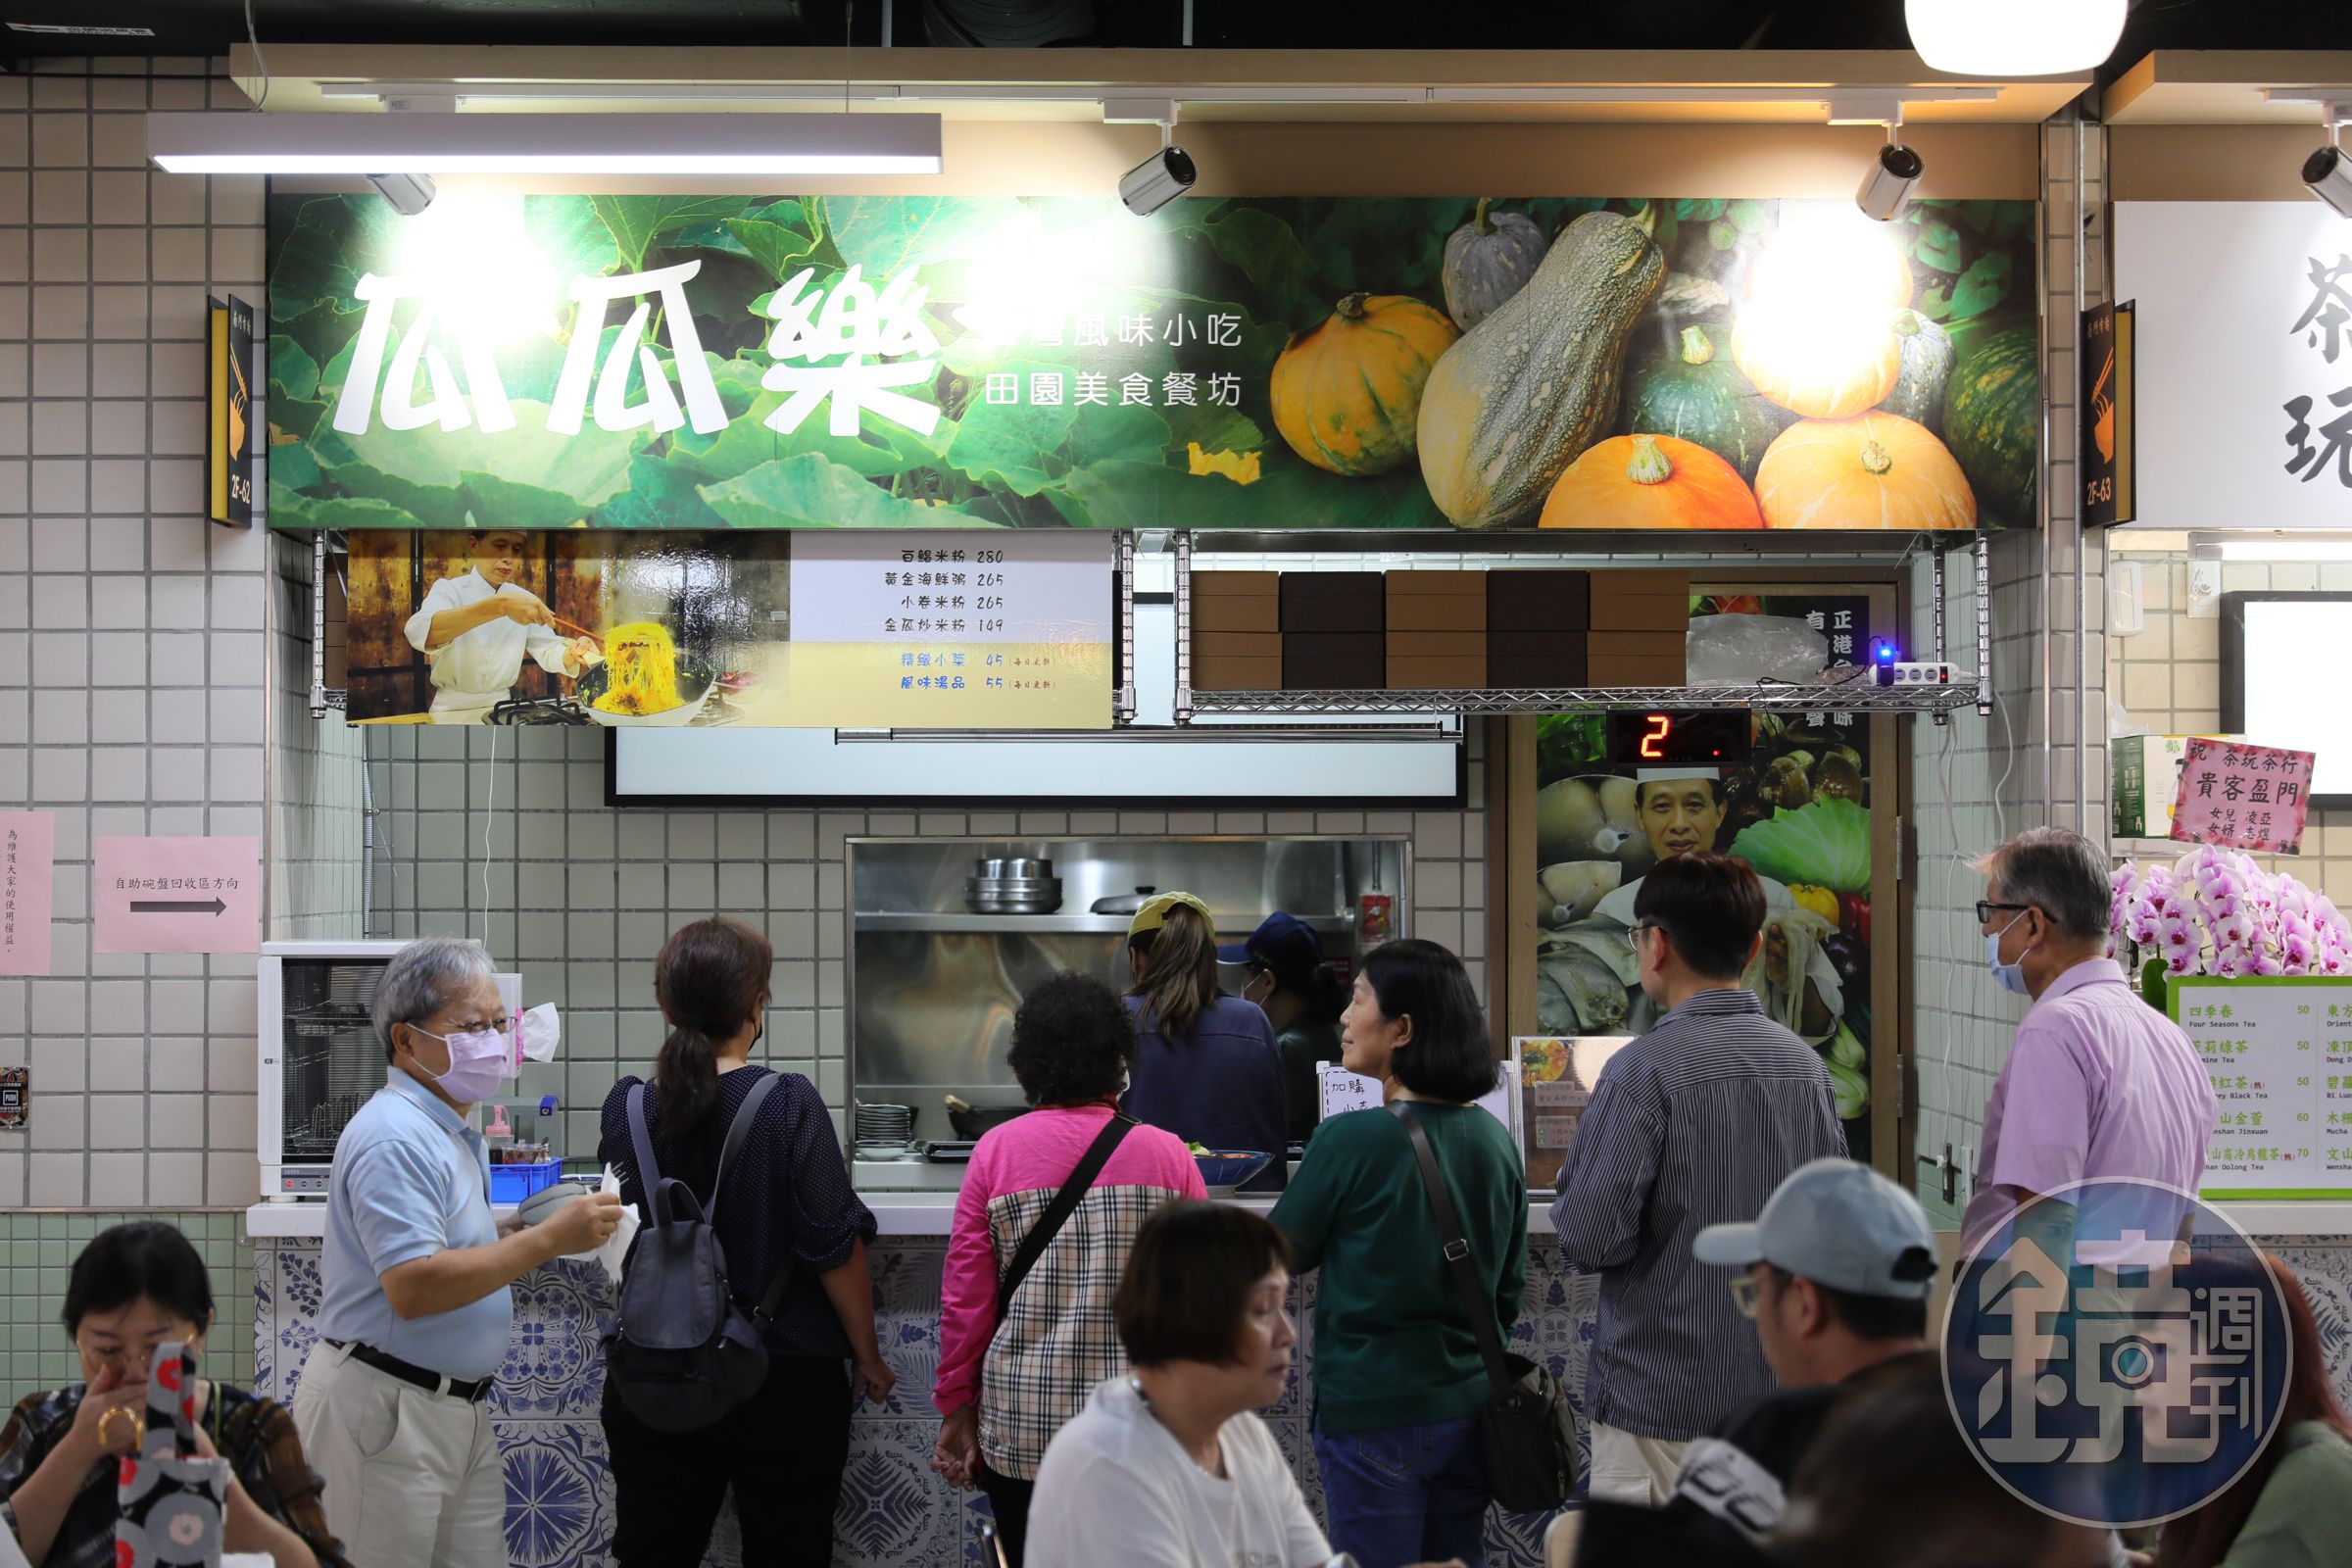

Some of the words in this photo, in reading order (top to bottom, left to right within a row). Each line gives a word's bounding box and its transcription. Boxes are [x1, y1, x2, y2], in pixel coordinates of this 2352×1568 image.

[1029, 312, 1243, 347] 風味小吃
[332, 259, 942, 438] 瓜瓜樂
[985, 371, 1242, 407] 田園美食餐坊
[231, 474, 251, 505] 2F-62
[2086, 477, 2111, 506] 2F-63
[977, 550, 1004, 564] 280
[884, 572, 966, 586] 黃金海鮮粥
[977, 573, 1004, 587] 265
[901, 596, 965, 610] 小卷米粉
[977, 596, 1004, 610] 265
[884, 618, 966, 632] 金瓜炒米粉
[979, 619, 1004, 632] 149
[986, 654, 1004, 666] 45
[1834, 611, 1853, 727] 正港味
[901, 676, 965, 690] 風味湯品
[986, 676, 1004, 689] 55
[1641, 715, 1669, 758] 2
[2189, 742, 2207, 761] 祝
[2222, 750, 2298, 774] 茶玩茶行
[2197, 771, 2299, 807] 貴客盈門
[2210, 807, 2236, 823] 女兒
[2207, 822, 2235, 839] 女婿
[116, 877, 238, 890] 自助碗盤回收區方向
[2189, 1004, 2232, 1018] 四季春
[2297, 1005, 2310, 1014] 50
[2297, 1042, 2310, 1051] 50
[1332, 1078, 1365, 1095] 加購
[2220, 1112, 2263, 1125] 山金萱
[2212, 1149, 2279, 1161] 山高冷烏龍茶
